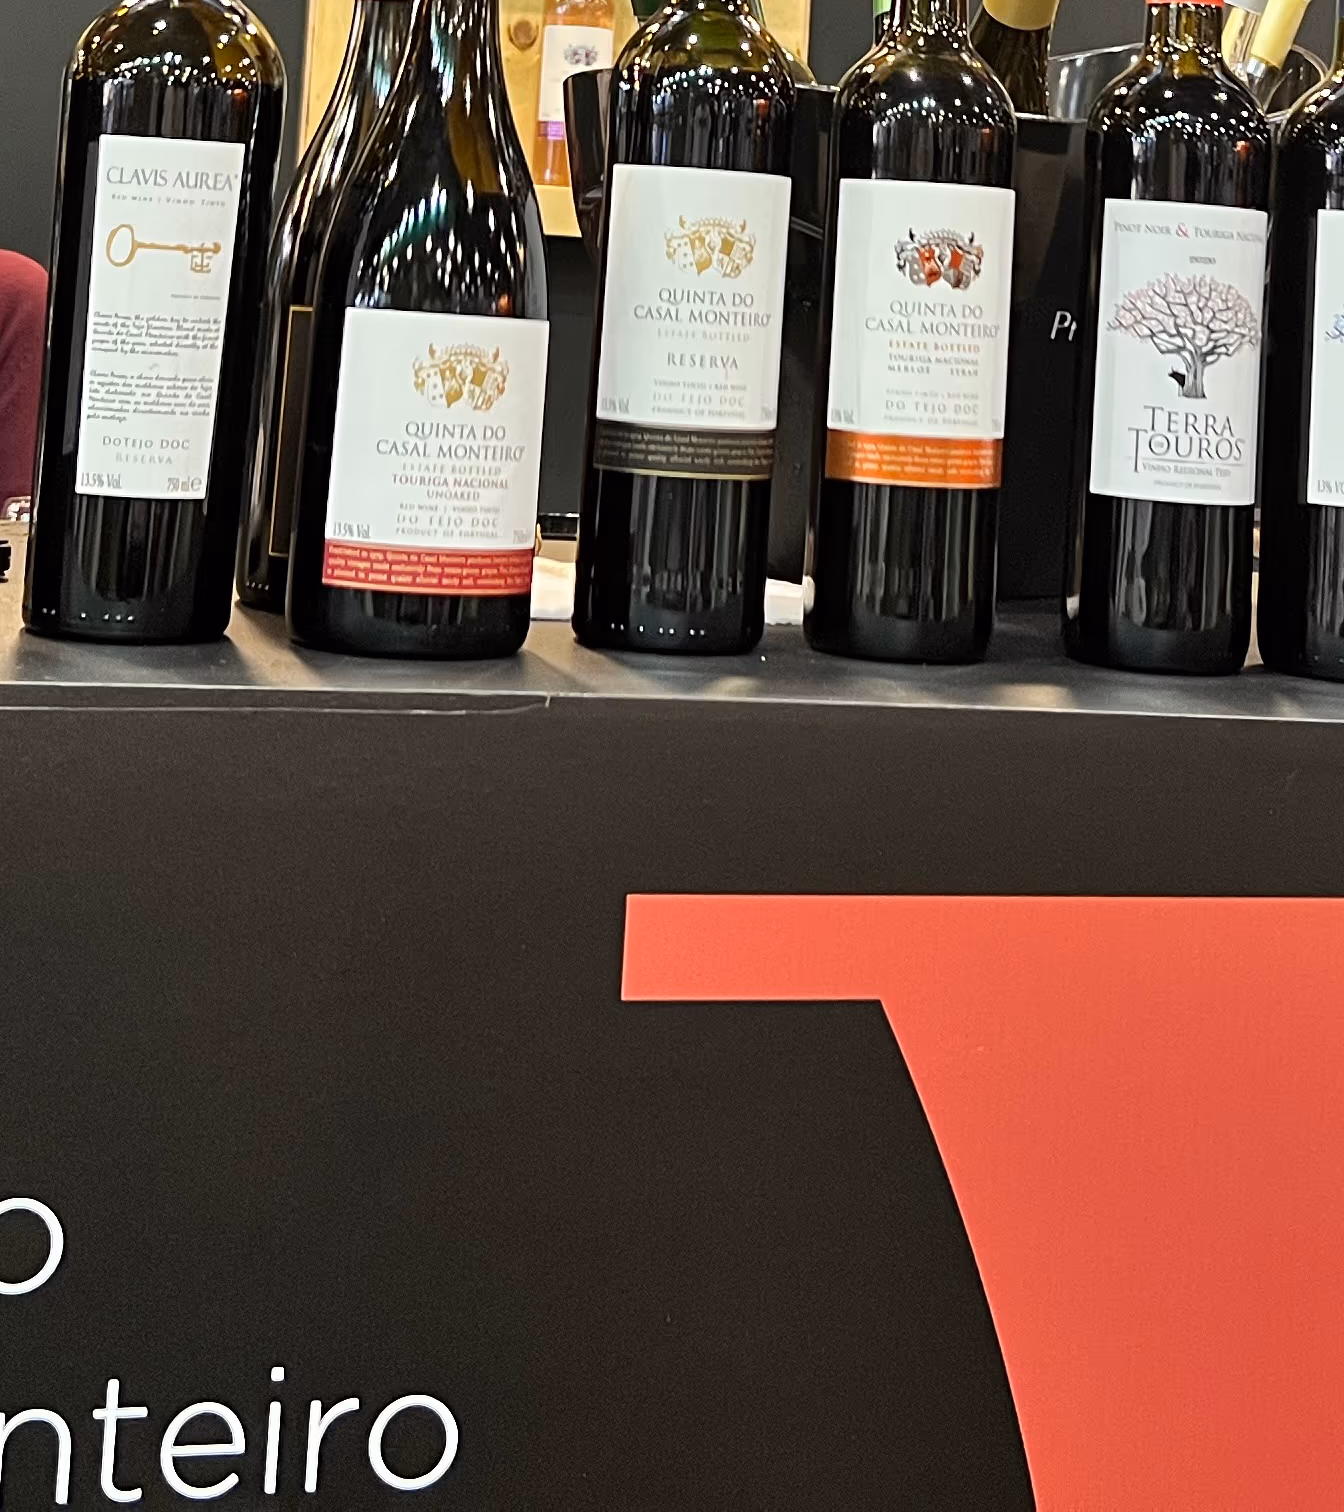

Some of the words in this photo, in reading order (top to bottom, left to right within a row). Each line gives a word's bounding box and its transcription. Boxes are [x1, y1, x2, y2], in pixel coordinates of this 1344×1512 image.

[107, 166, 168, 186] CLAVIS
[172, 171, 234, 192] AUREA
[1175, 222, 1189, 238] &
[659, 287, 726, 306] QUINTA
[732, 292, 754, 307] DO
[633, 304, 682, 322] CASAL
[689, 308, 771, 328] MONTEIRO
[889, 299, 956, 319] QUINTA
[962, 304, 983, 318] DO
[865, 317, 914, 334] CASAL
[920, 321, 1000, 339] MONTEIRO
[889, 340, 928, 351] ESTATE
[934, 341, 980, 353] BOTTLED
[667, 352, 739, 370] RESERVA
[886, 399, 907, 411] DO
[914, 400, 947, 414] TEJO
[953, 403, 979, 415] DOC
[406, 420, 477, 441] QUINTA
[483, 425, 506, 441] DO
[1143, 405, 1234, 438] TERRA
[160, 438, 190, 450] DOC
[376, 440, 431, 458] CASAL
[437, 444, 525, 463] MONTEIRO
[1127, 427, 1246, 473] TOUROS
[115, 452, 173, 465] RESERVA
[392, 474, 448, 488] TOURIGA
[453, 477, 508, 490] NACIONAL
[427, 490, 480, 501] UNOAKED
[397, 514, 419, 525] DO
[429, 515, 462, 527] TEJO
[471, 517, 499, 529] DOC
